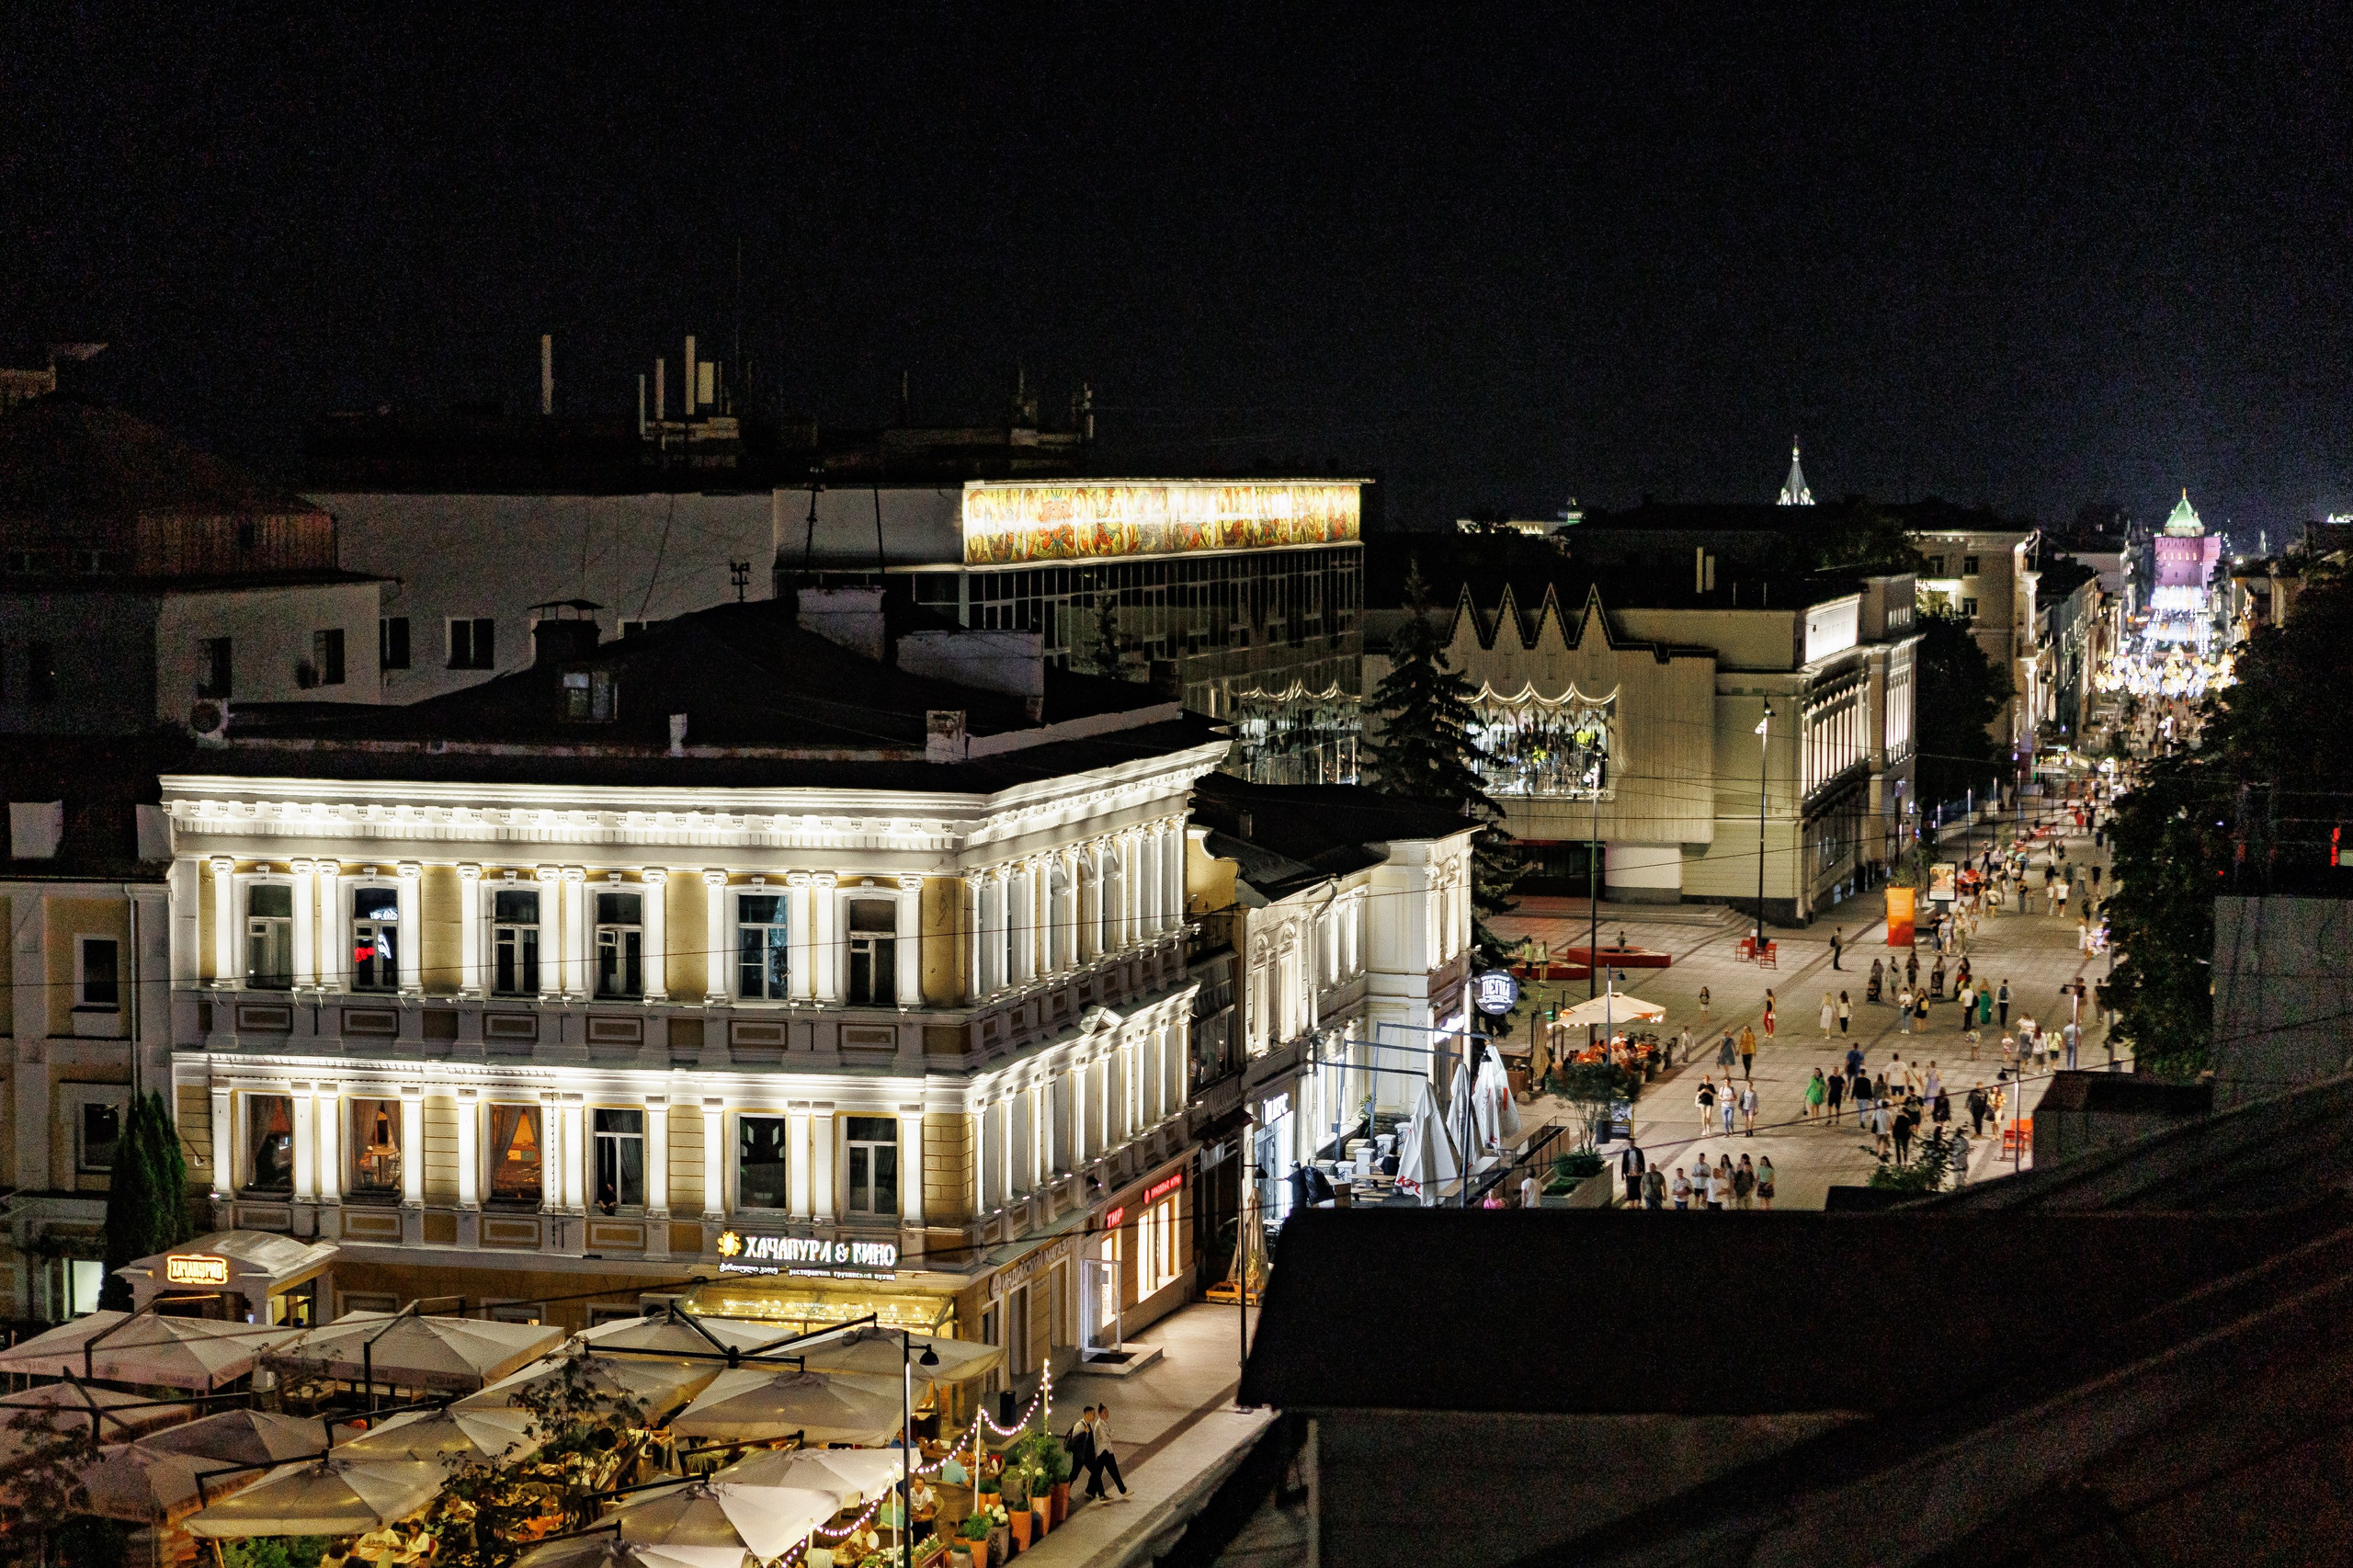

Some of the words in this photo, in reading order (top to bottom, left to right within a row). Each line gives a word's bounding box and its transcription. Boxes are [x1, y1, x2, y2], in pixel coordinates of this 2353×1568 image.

[1396, 1175, 1421, 1195] KFC
[1106, 1207, 1124, 1229] ТИР
[745, 1236, 832, 1262] ХАЧАПУРИ
[835, 1243, 849, 1263] &
[852, 1243, 897, 1267] ВИНО
